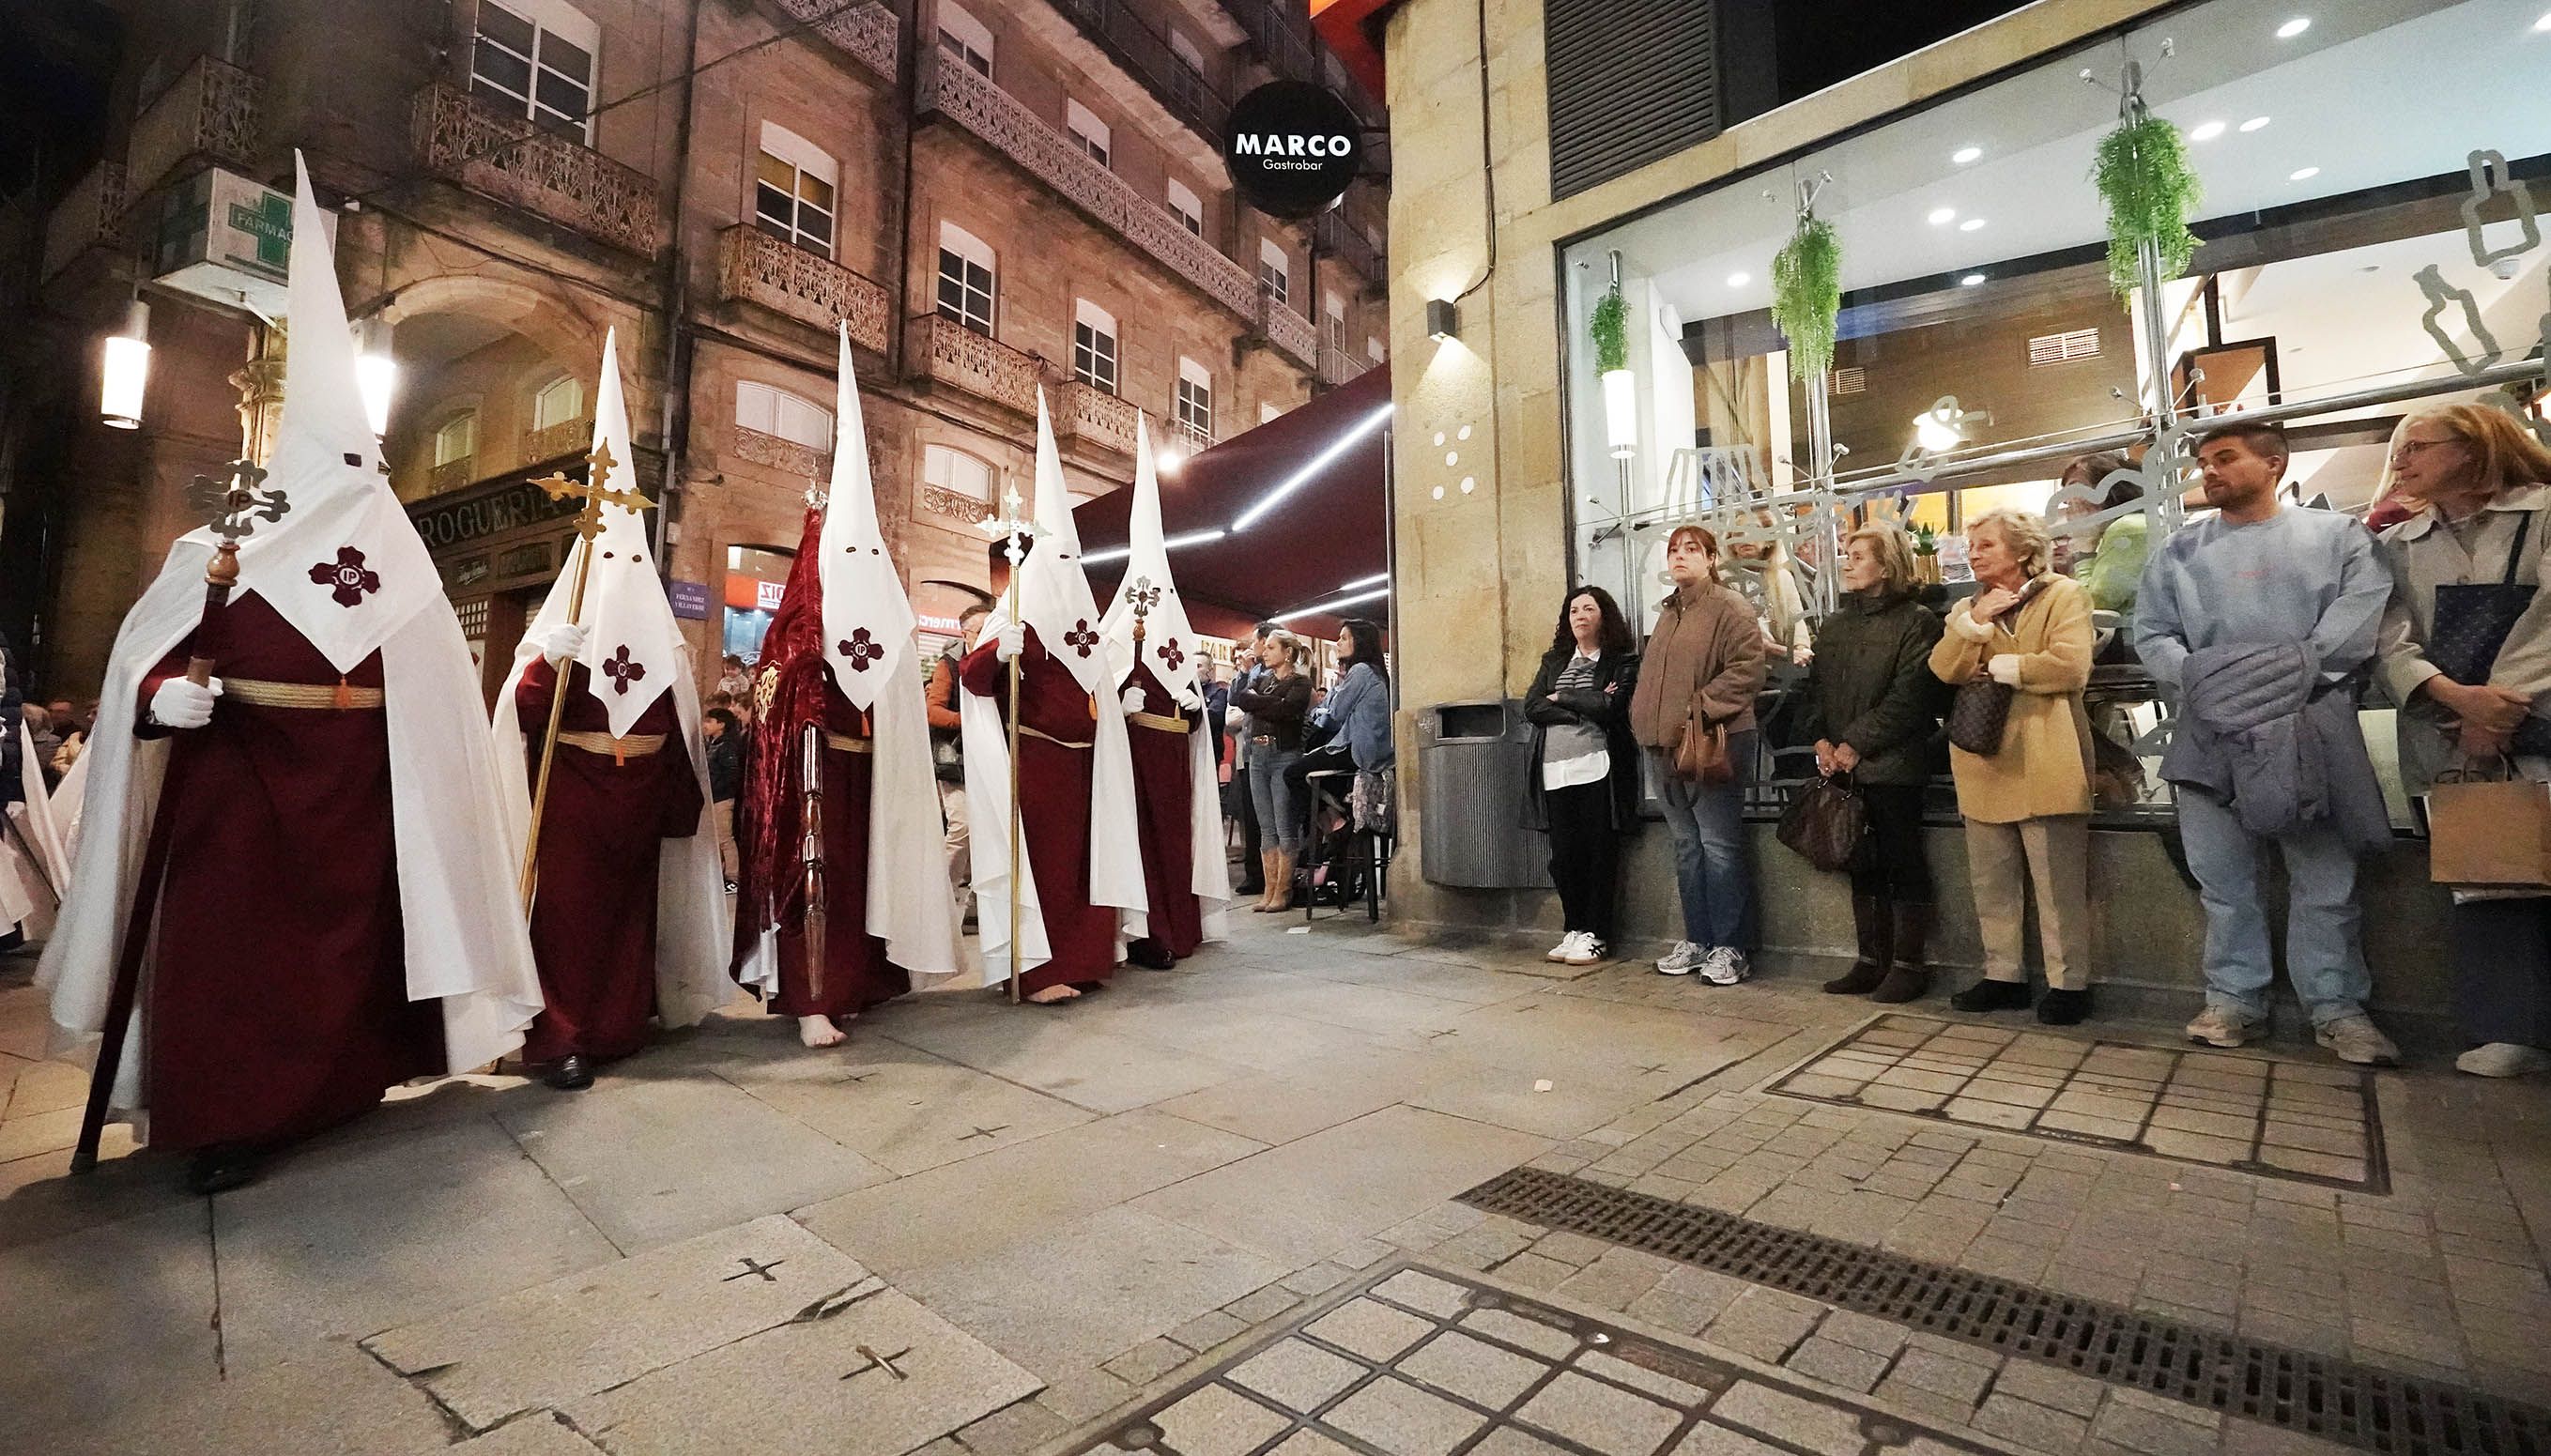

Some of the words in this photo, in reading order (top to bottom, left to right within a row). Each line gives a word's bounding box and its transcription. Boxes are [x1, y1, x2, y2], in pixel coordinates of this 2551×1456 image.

[1236, 133, 1351, 157] MARCO
[1263, 158, 1323, 171] Gastrobar
[343, 570, 358, 583] IP
[857, 645, 866, 654] IP
